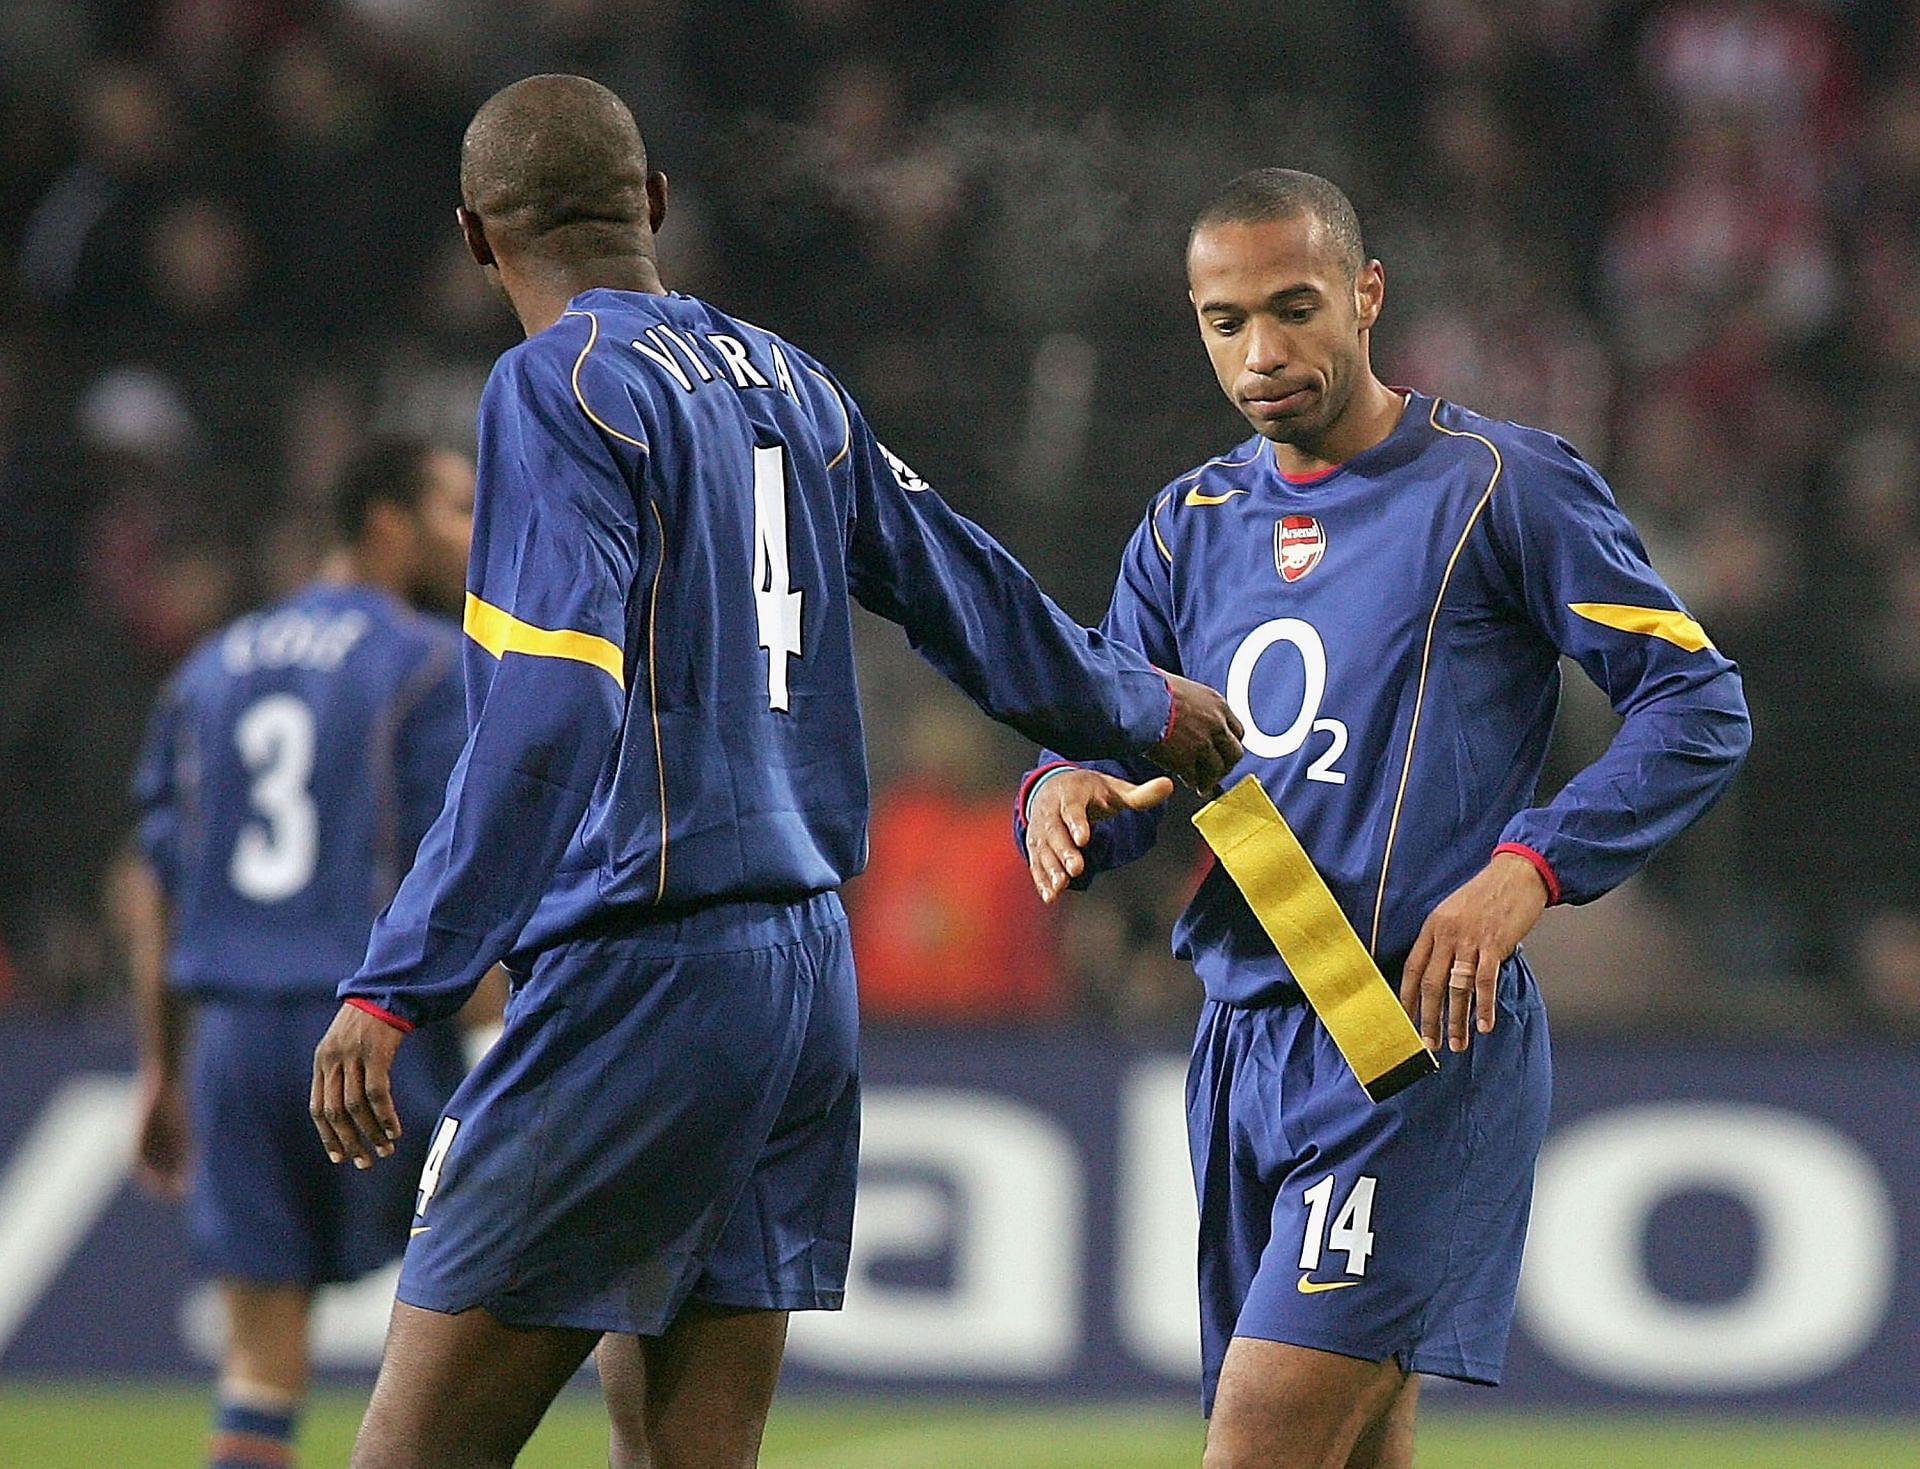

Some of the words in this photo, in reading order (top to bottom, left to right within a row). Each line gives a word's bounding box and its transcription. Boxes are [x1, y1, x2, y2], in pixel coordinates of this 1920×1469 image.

[752, 444, 803, 711] 4
[1226, 617, 1349, 784] O2
[230, 693, 320, 902] 3
[416, 1115, 460, 1218] 4
[1298, 1173, 1378, 1277] 14
